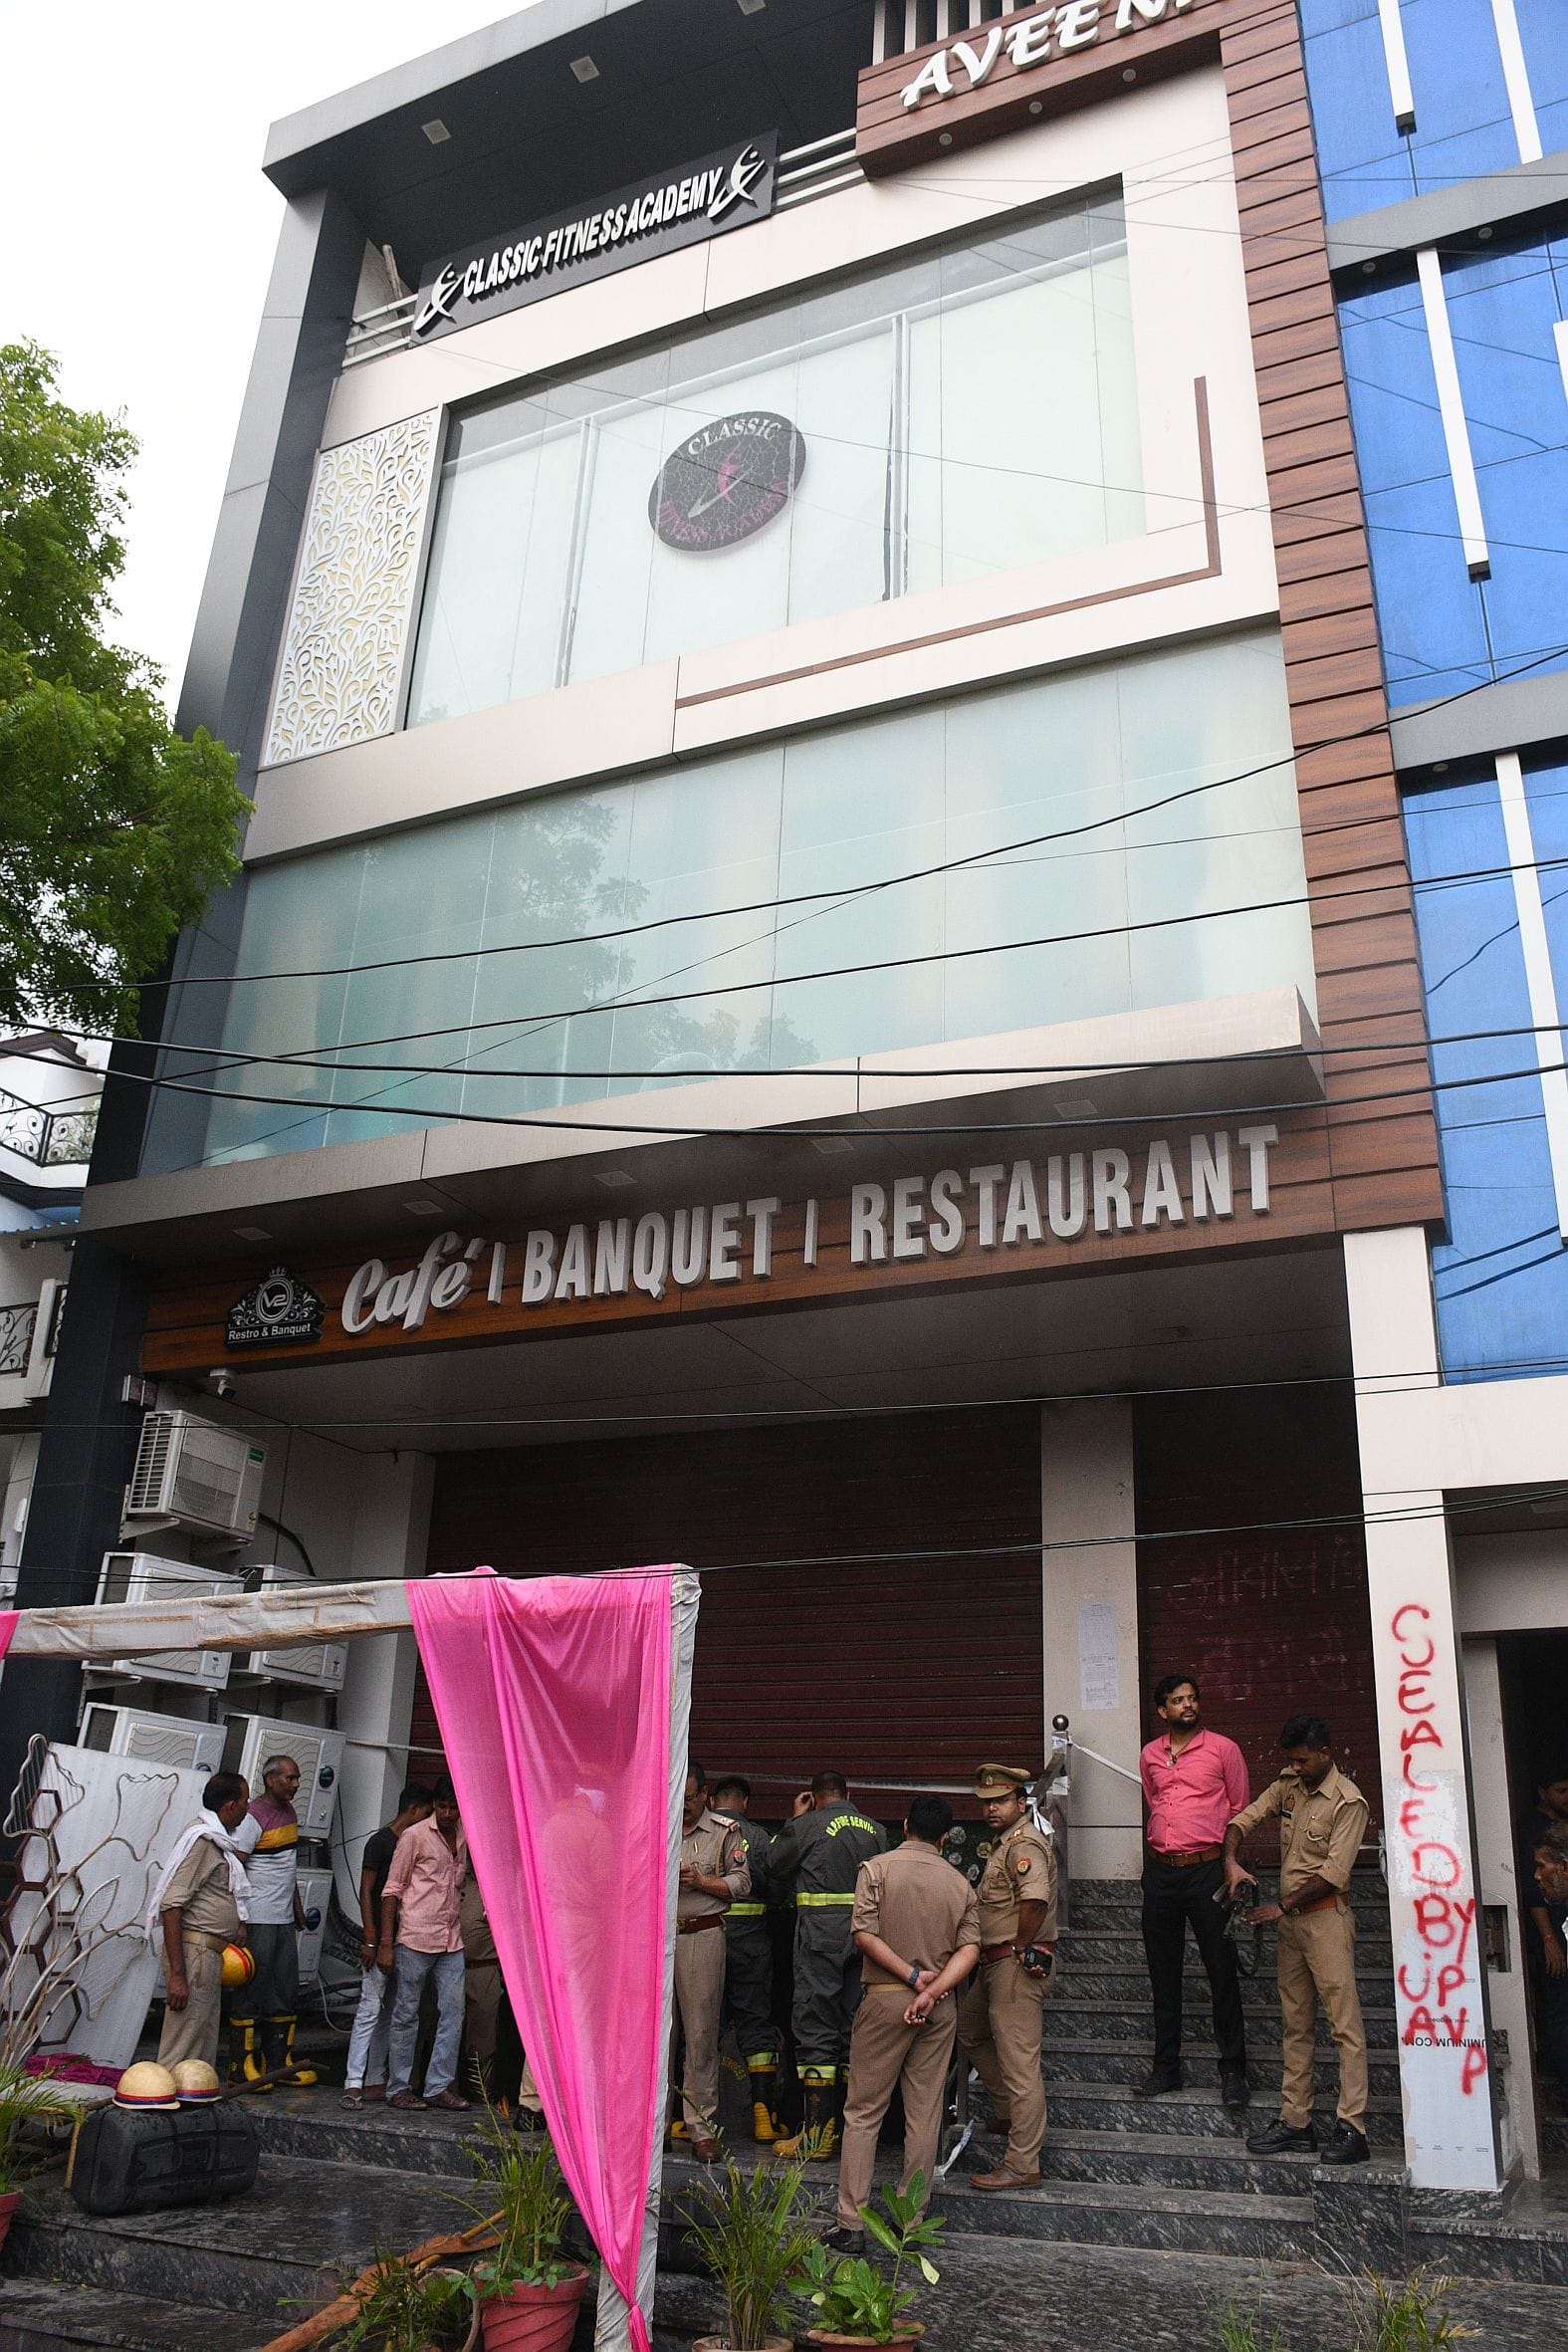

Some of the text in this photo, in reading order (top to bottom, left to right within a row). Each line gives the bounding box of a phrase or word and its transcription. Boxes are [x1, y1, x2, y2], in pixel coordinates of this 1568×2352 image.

[900, 0, 1192, 109] AVEEN
[463, 166, 724, 300] CLASSIC FITNESS ACADEMY
[687, 417, 783, 456] CLASSIC
[341, 1231, 486, 1334] Café
[521, 1197, 783, 1305] BANQUET
[850, 1124, 1278, 1265] RESTAURANT
[228, 1322, 312, 1341] Restro & Banquet
[263, 1291, 288, 1308] V2
[1413, 1892, 1475, 1966] BY
